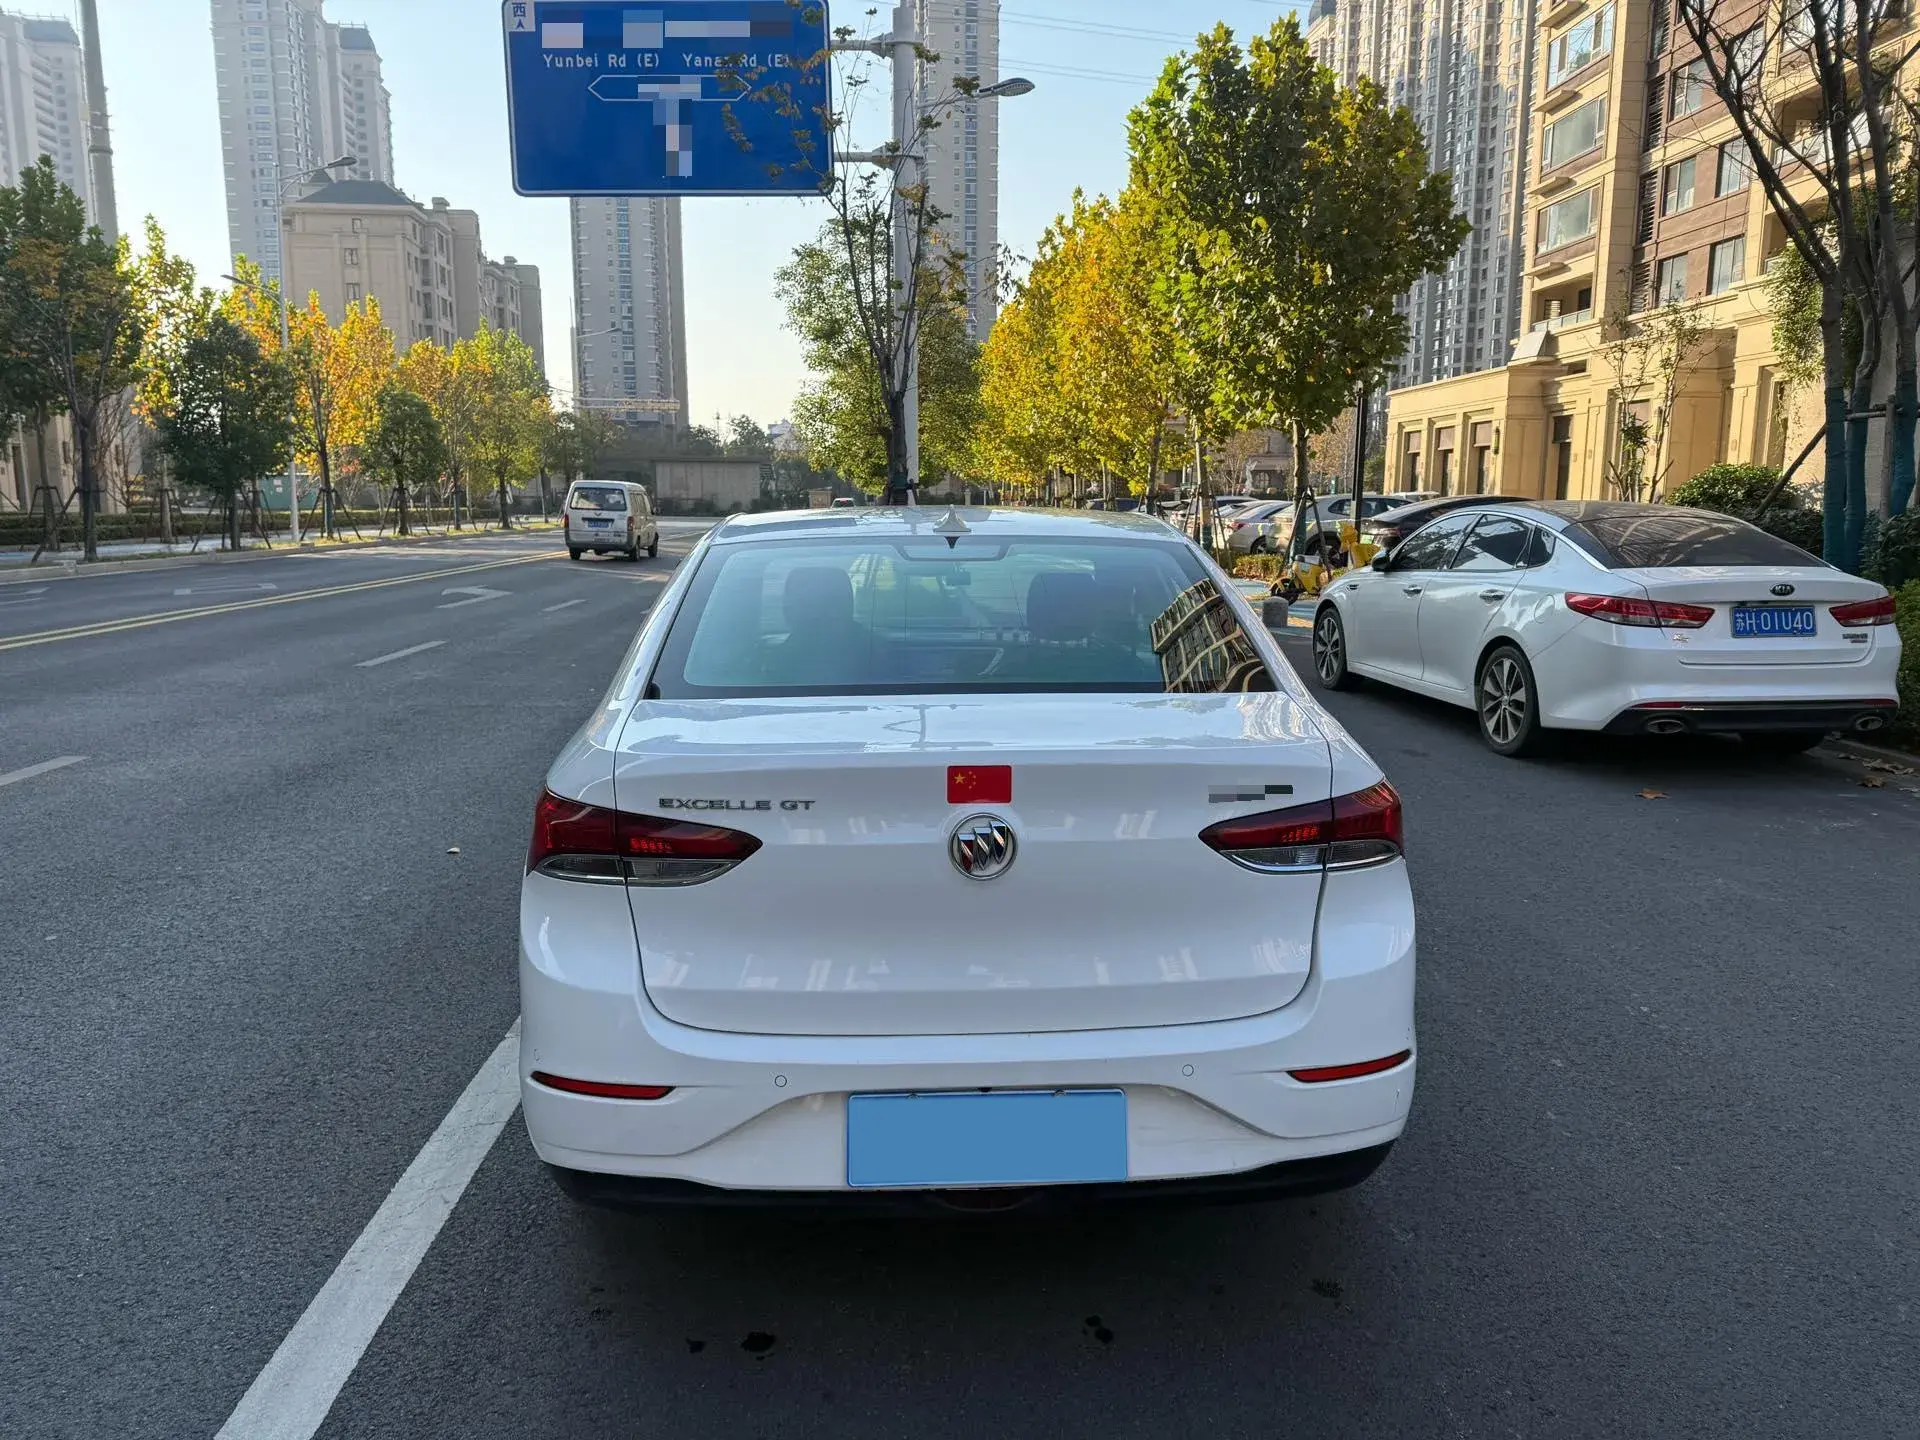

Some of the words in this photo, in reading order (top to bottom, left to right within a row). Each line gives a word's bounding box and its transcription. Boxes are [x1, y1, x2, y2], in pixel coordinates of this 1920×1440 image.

[511, 2, 527, 18] 西
[543, 53, 599, 68] Yunbei
[608, 54, 627, 68] Rd
[637, 53, 660, 69] (E)
[740, 53, 757, 68] Rd
[1775, 585, 1792, 594] KIA
[658, 798, 771, 811] EXCELLE
[780, 800, 816, 811] GT
